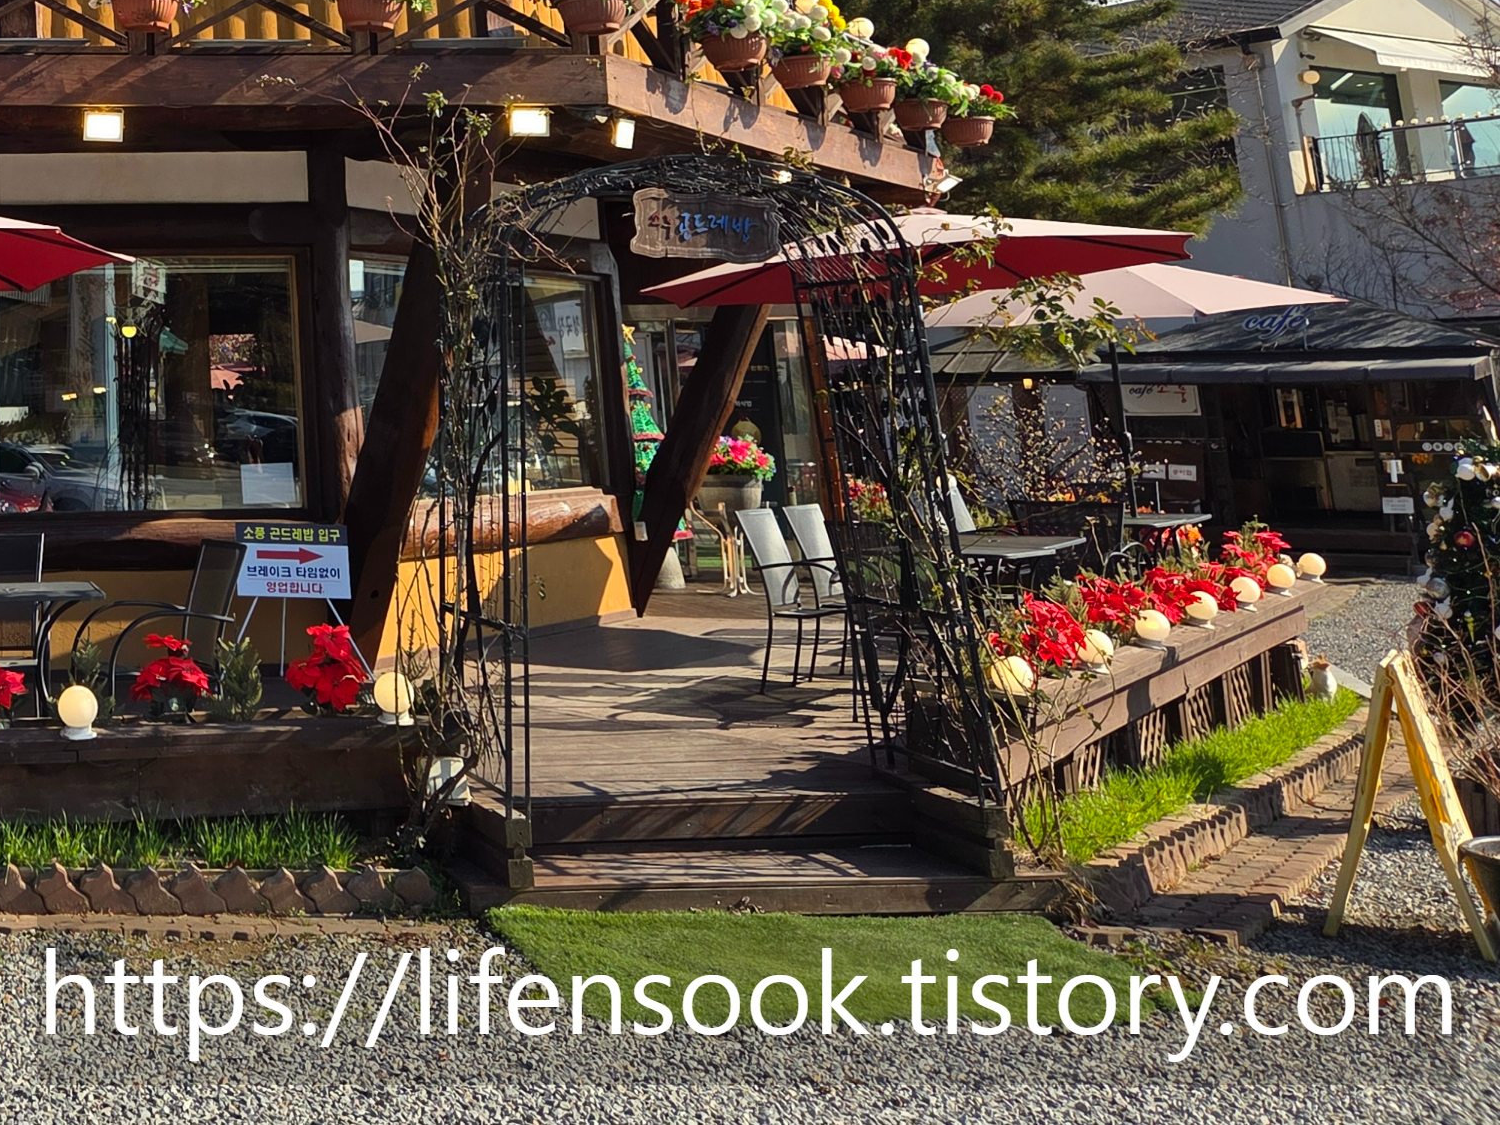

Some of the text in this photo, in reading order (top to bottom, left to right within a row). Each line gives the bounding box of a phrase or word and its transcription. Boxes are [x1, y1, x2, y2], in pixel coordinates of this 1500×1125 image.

[243, 526, 341, 543] 소풍 곤드레밥 입구
[247, 565, 341, 580] 브레이크 타임없이
